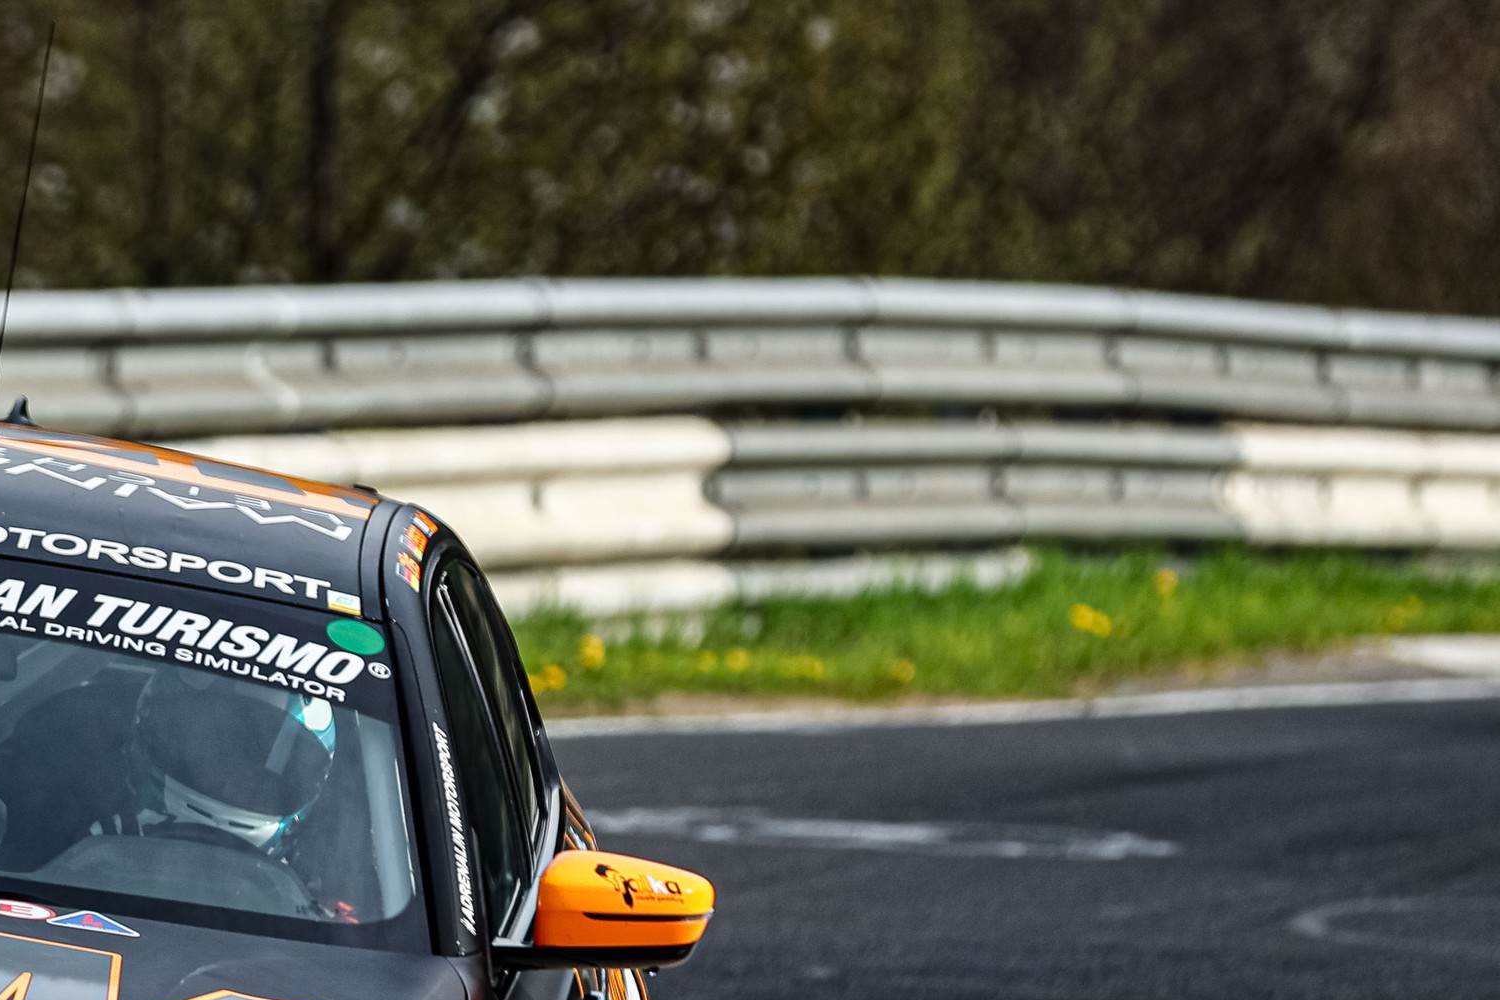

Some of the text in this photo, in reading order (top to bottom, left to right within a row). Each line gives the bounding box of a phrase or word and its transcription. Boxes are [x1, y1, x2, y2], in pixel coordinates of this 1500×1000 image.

[44, 622, 166, 657] DRIVING
[174, 646, 345, 701] SIMULATOR
[91, 593, 366, 685] TURISMO
[432, 722, 463, 829] MOTORSPORT
